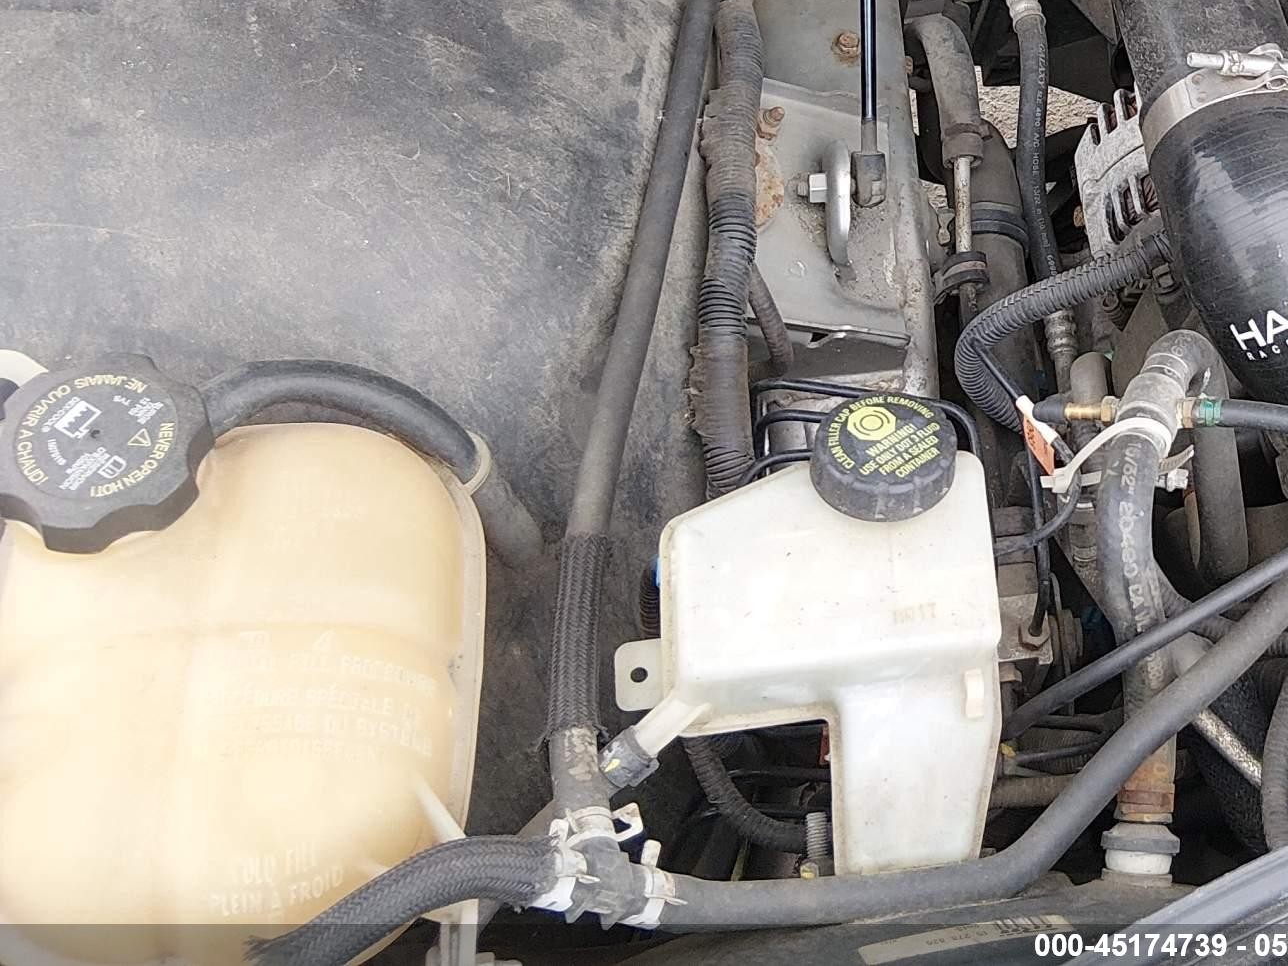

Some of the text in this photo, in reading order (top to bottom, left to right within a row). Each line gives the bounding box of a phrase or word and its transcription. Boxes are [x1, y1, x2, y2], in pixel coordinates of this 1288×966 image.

[74, 374, 124, 388] JAMAIS
[124, 379, 149, 395] NE
[22, 384, 72, 427] OUVRIR
[151, 422, 176, 460] NEVER
[827, 395, 935, 470] CLEAN FILLER CAP BEFORE REMOVING
[859, 422, 941, 477] USE ONLY DOT 3 FLUID
[865, 423, 918, 457] WARNING!
[16, 441, 50, 487] CHAUD!
[879, 435, 940, 477] FROM A SEALED
[895, 447, 941, 479] CONTAINER
[89, 480, 126, 498] HOT!
[122, 460, 158, 489] OPEN
